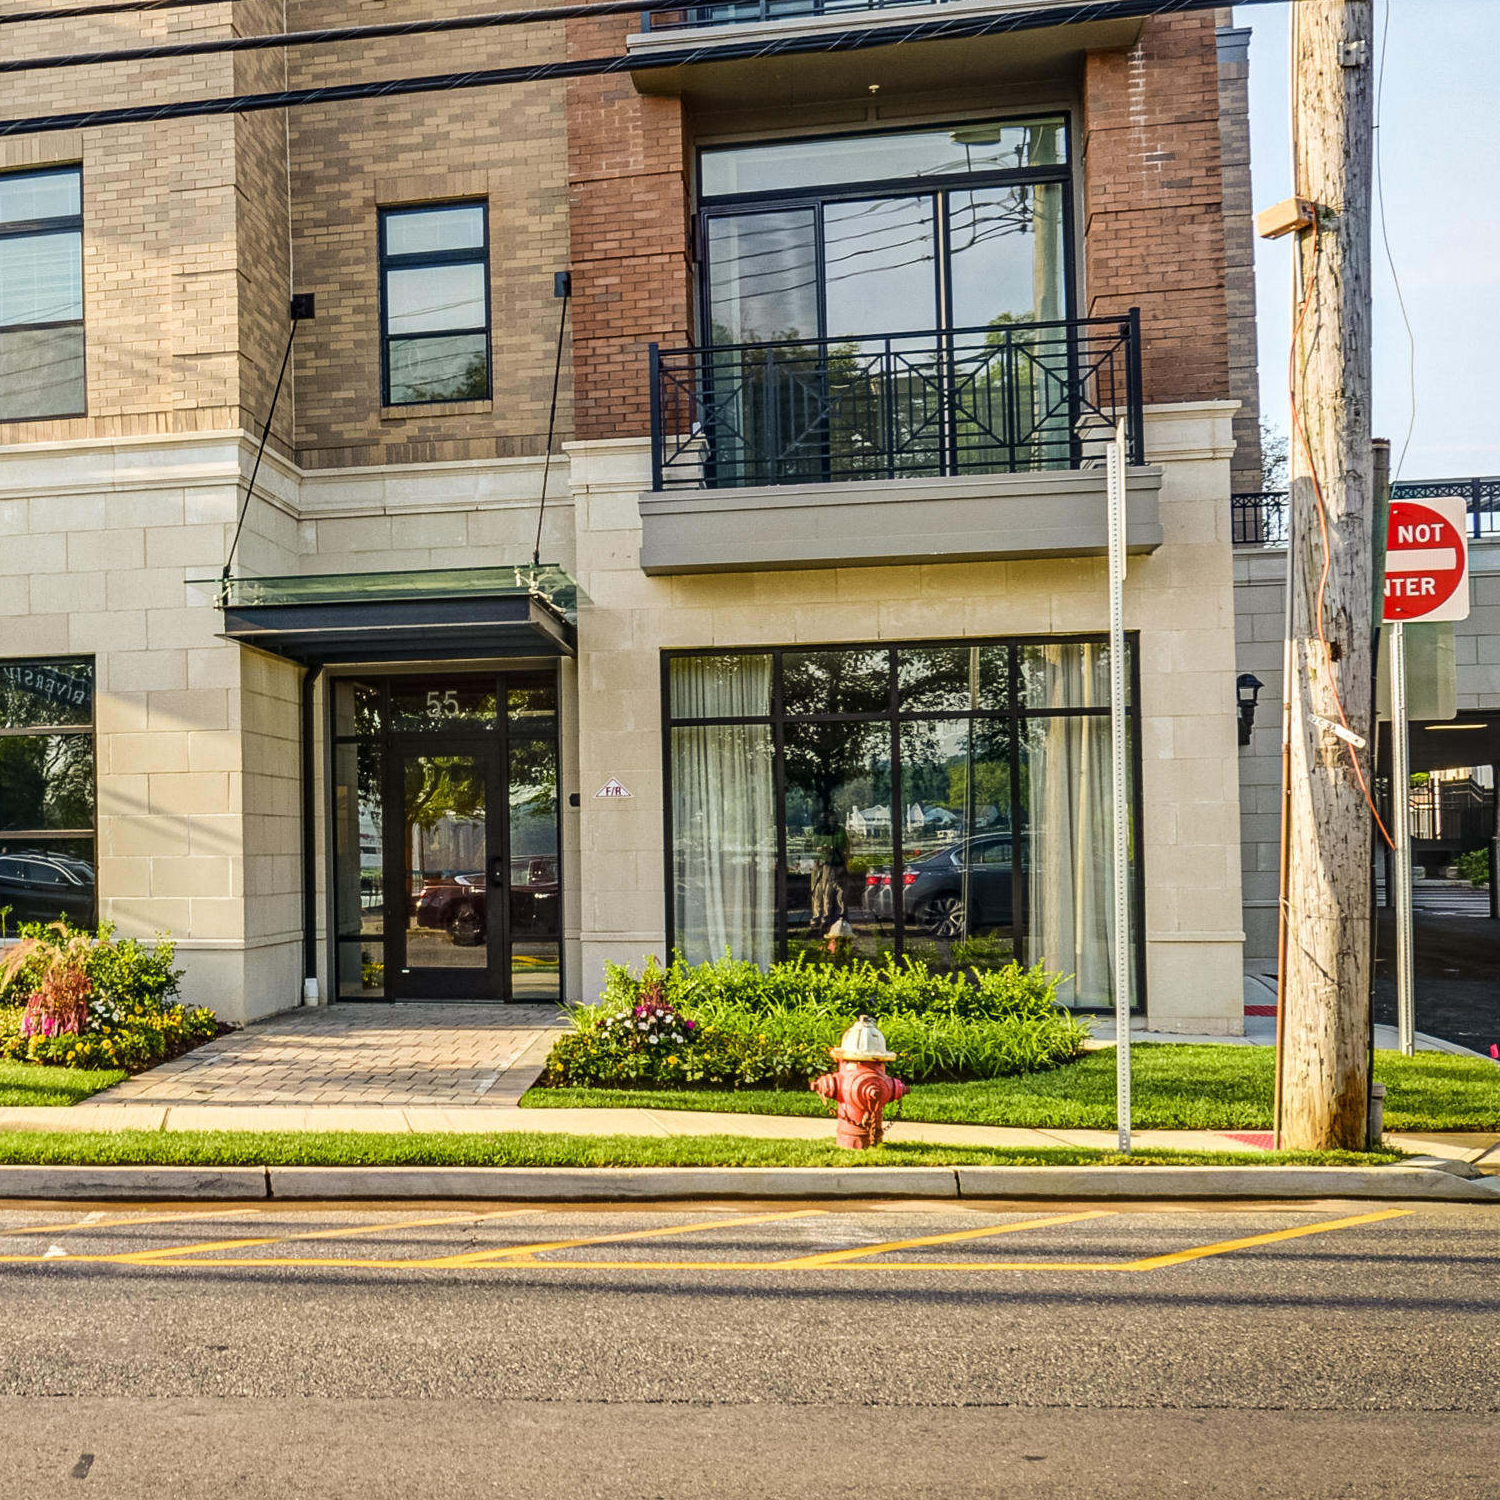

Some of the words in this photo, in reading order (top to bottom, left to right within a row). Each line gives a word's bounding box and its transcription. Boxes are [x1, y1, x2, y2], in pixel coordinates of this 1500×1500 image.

[1397, 523, 1444, 544] NOT
[426, 690, 459, 718] 55
[605, 786, 623, 797] F/R
